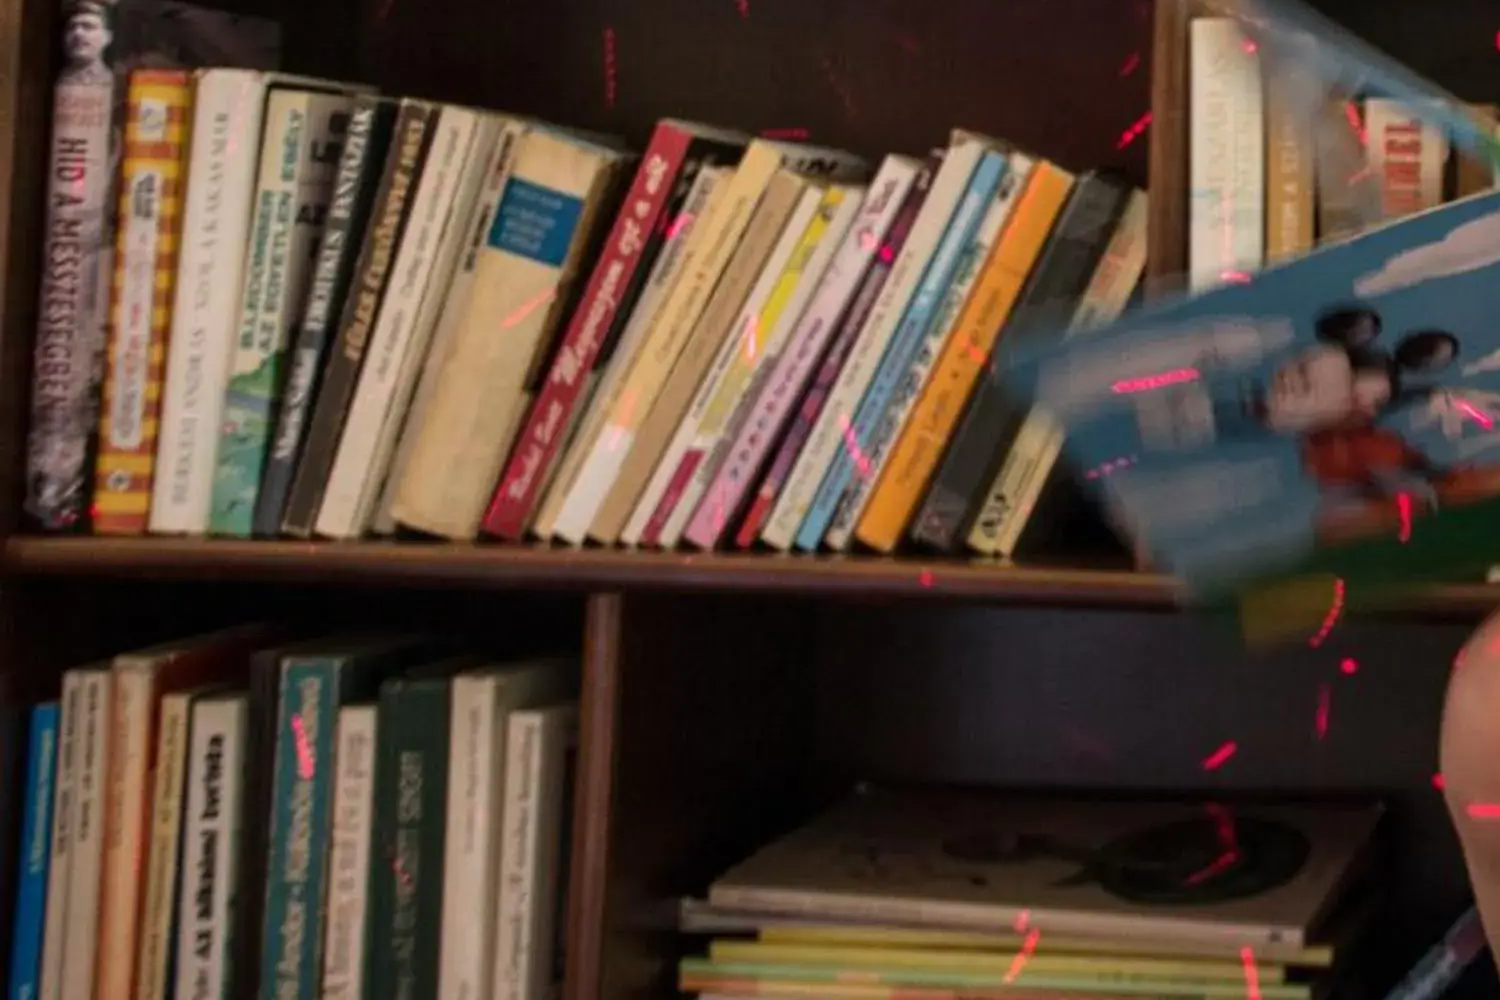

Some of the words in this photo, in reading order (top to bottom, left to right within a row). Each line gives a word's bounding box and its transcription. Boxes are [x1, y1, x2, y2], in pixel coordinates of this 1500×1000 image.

[198, 731, 225, 821] turista
[192, 828, 218, 921] alkalmi
[194, 927, 212, 959] Az
